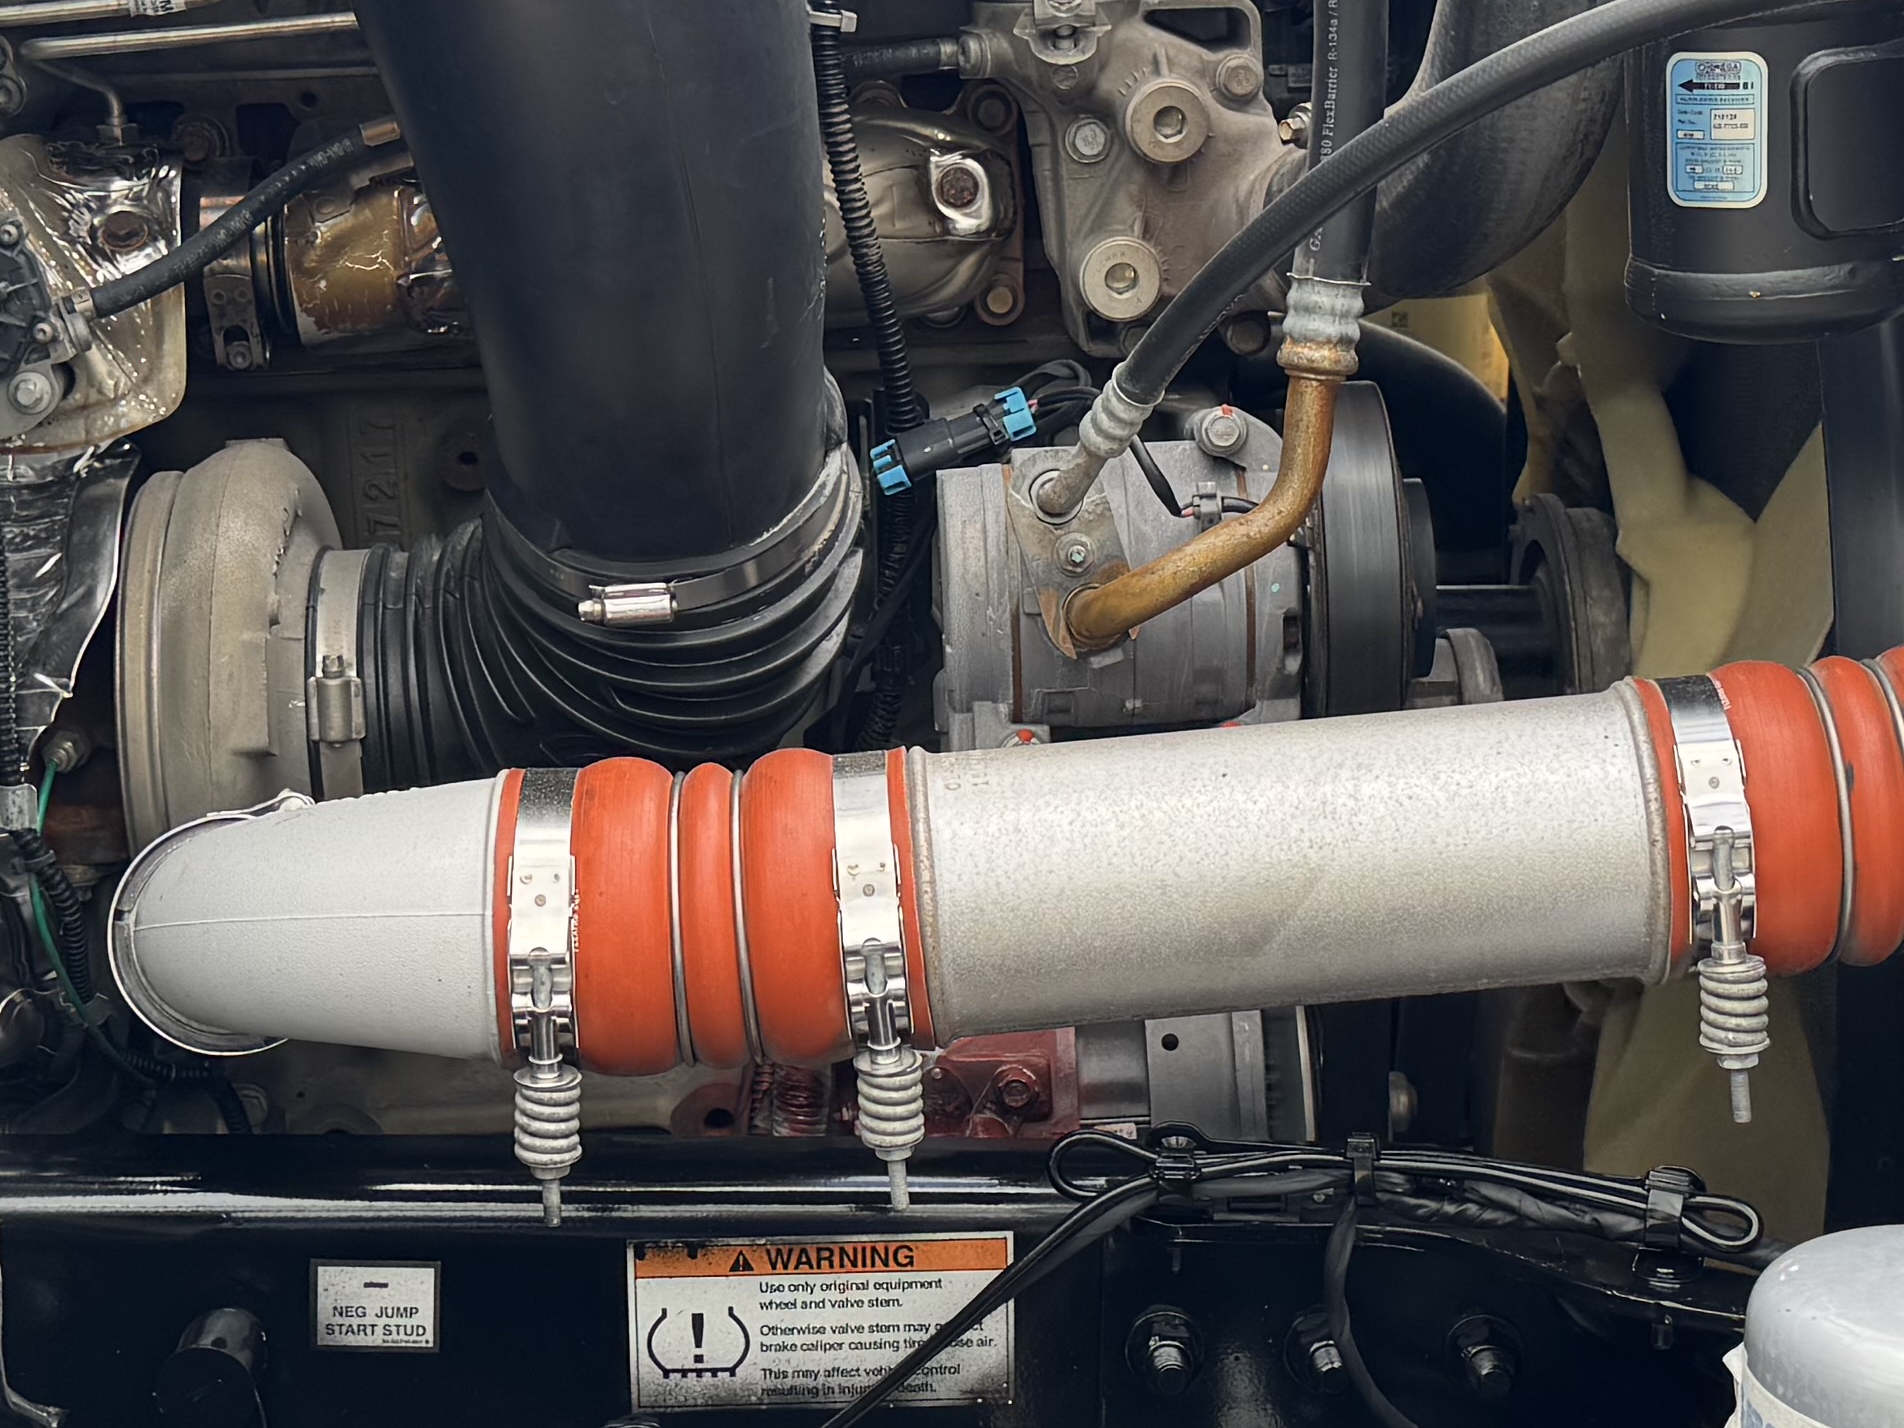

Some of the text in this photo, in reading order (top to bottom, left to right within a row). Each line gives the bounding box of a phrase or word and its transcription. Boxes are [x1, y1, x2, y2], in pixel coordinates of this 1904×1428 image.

[765, 1244, 915, 1271] WARNING
[759, 1277, 943, 1295] Use only original equipment
[759, 1296, 904, 1311] wheel and valve stem.
[332, 1305, 420, 1319] NEG JUMP
[325, 1323, 427, 1337] START STUD
[759, 1323, 826, 1337] Otherwise
[830, 1323, 865, 1335] valve
[868, 1322, 901, 1334] stem
[903, 1323, 931, 1335] may
[759, 1341, 798, 1353] brake
[800, 1340, 845, 1355] caliper
[848, 1338, 900, 1355] causing
[949, 1338, 973, 1348] ose
[976, 1335, 997, 1348] air.
[760, 1367, 790, 1380] This
[822, 1365, 862, 1378] affect
